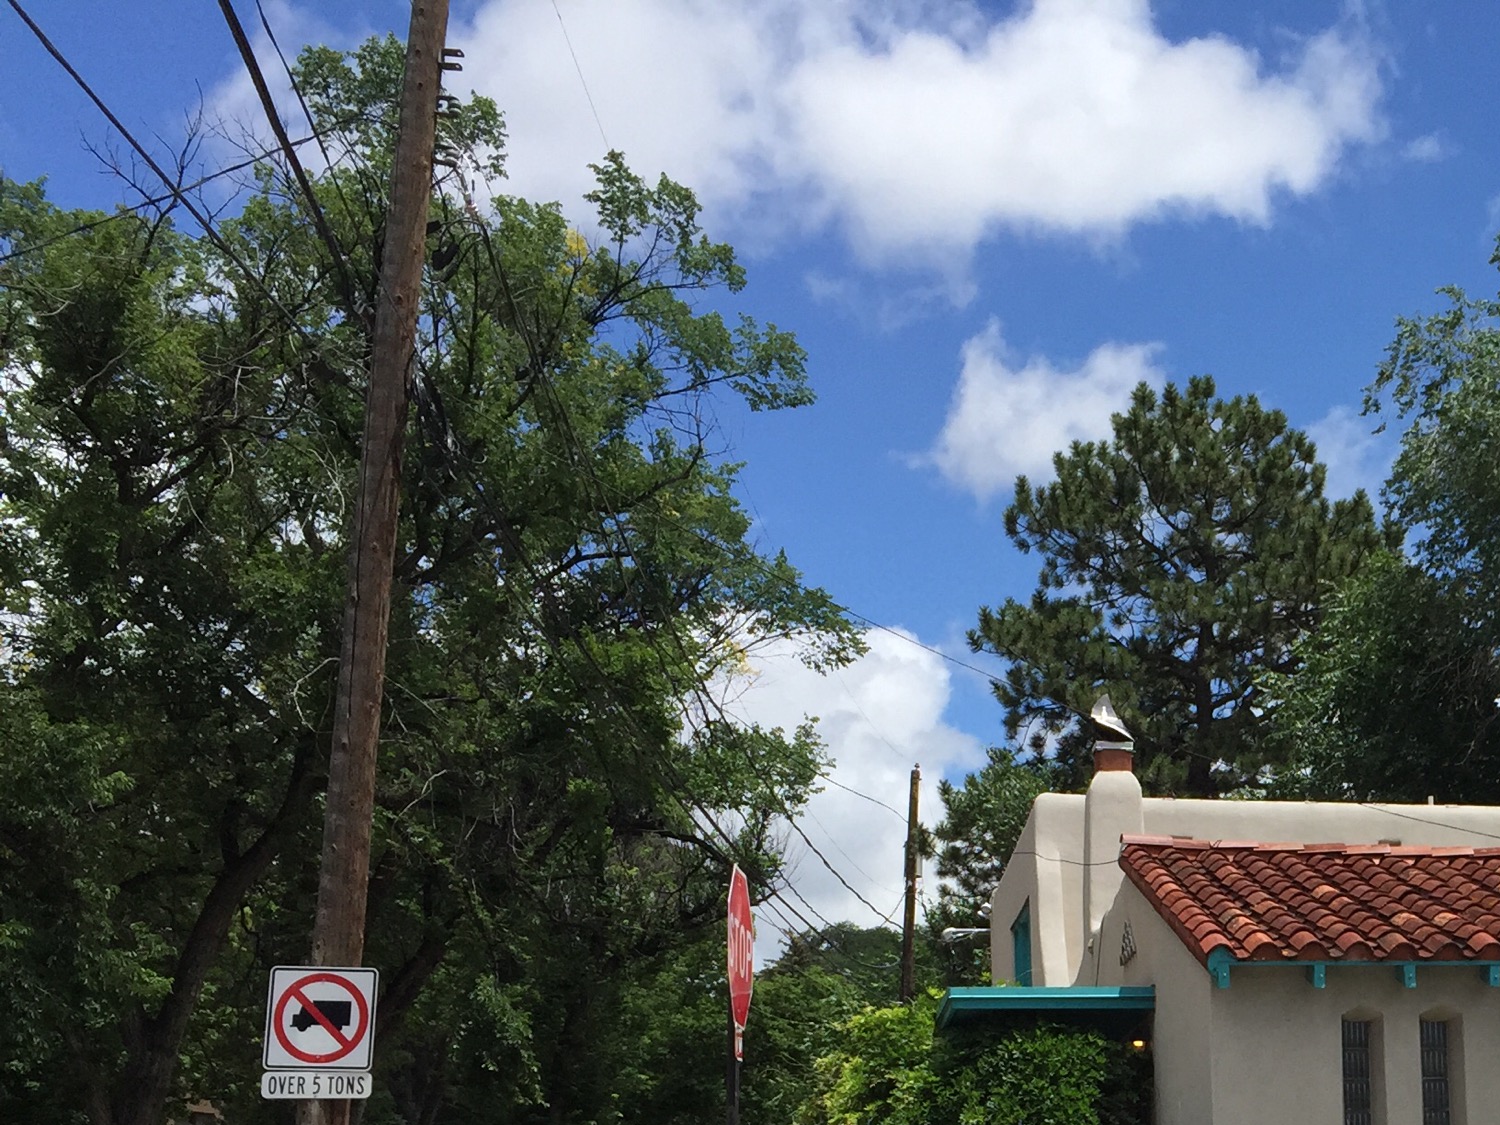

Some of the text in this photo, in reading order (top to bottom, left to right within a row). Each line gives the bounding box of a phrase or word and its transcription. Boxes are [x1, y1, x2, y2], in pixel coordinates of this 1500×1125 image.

[729, 912, 753, 983] STOP
[268, 1075, 366, 1095] OVER 5 TONS
